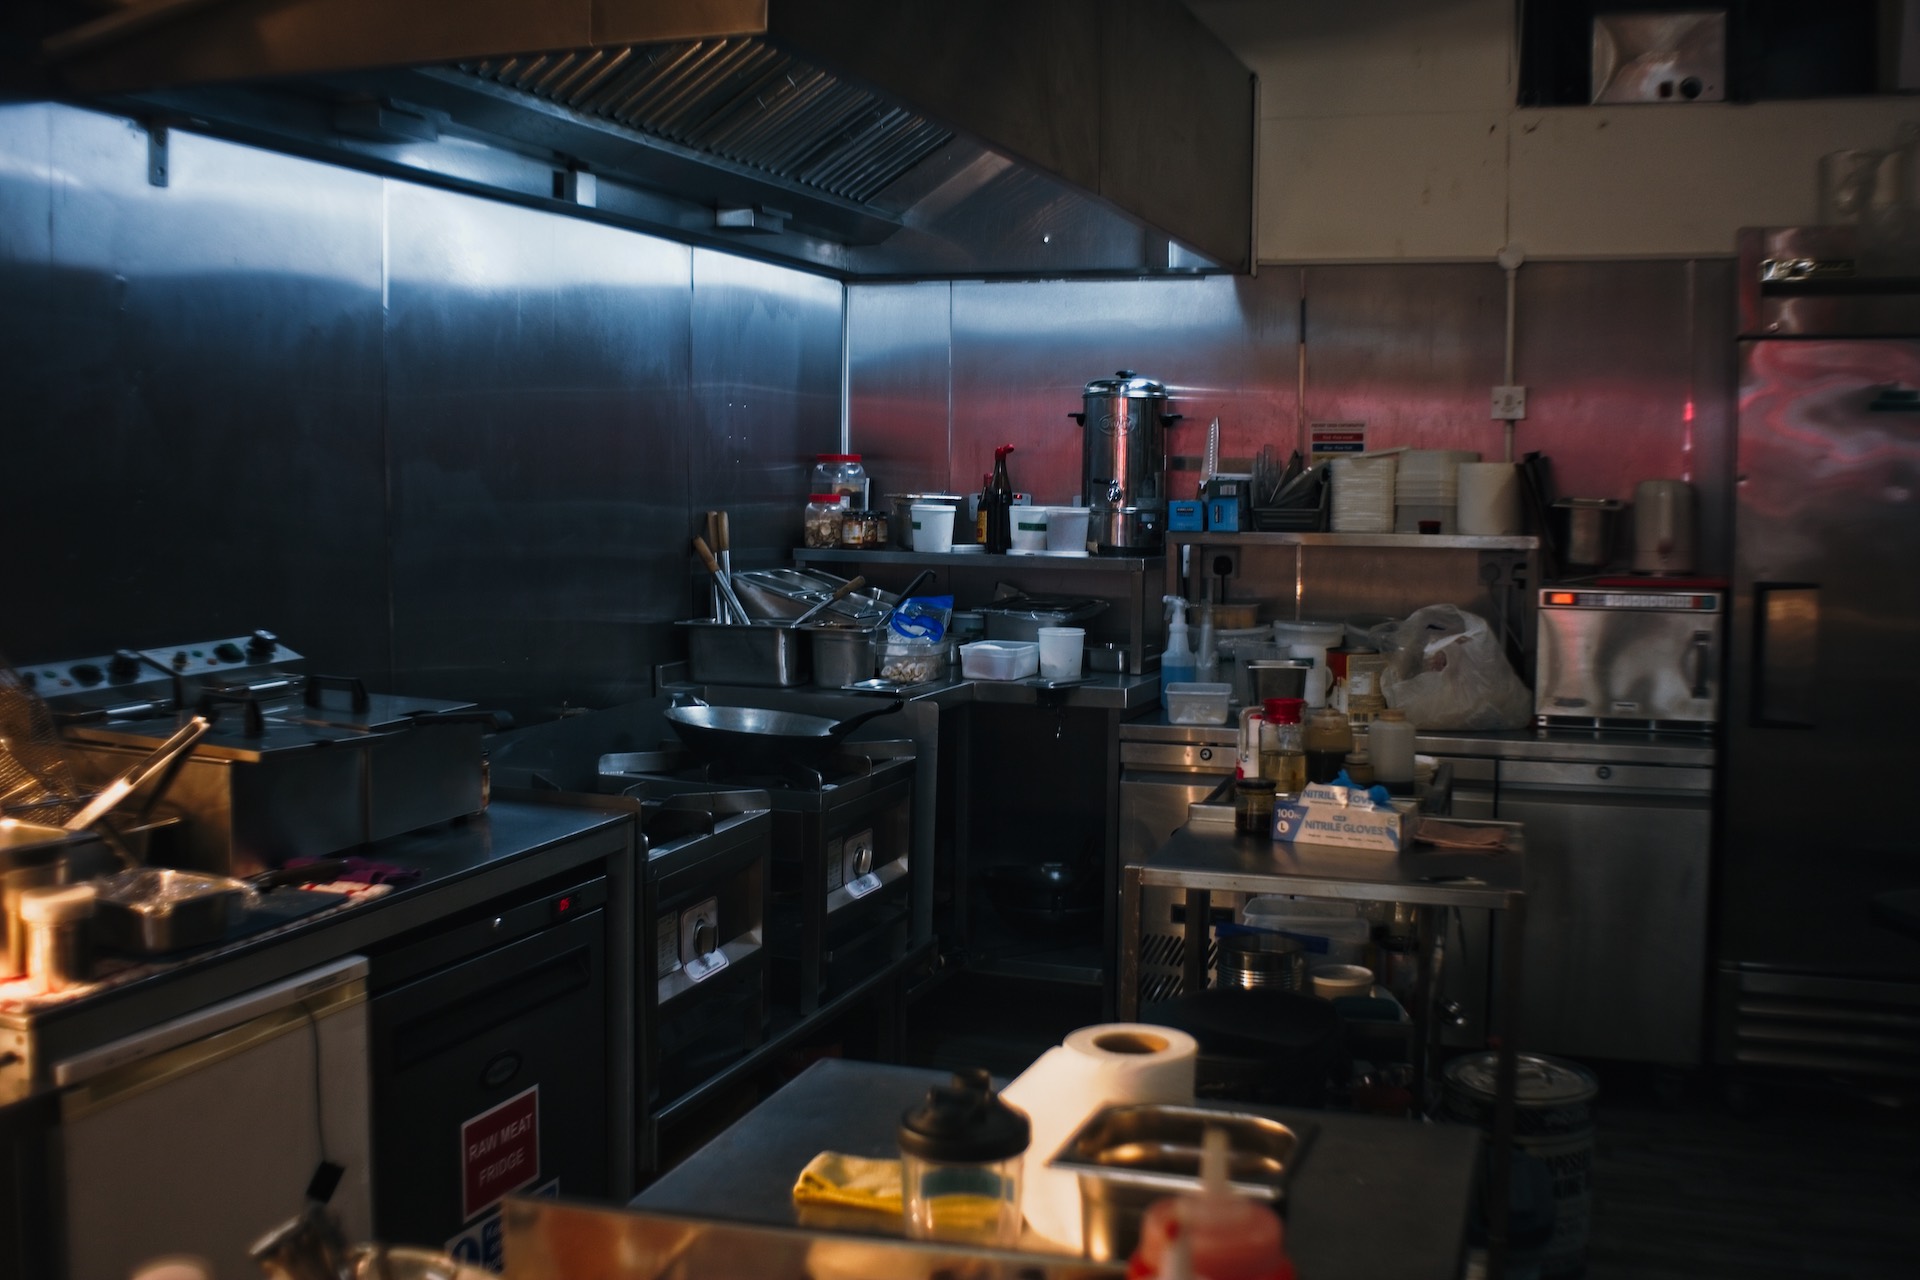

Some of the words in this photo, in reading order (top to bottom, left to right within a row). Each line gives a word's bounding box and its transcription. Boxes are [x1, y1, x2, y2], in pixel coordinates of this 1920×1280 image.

[1303, 790, 1337, 800] NITRILE
[1305, 820, 1341, 832] NITRILE
[1343, 823, 1383, 835] GLOVES
[469, 1132, 499, 1163] RAW
[500, 1113, 533, 1144] MEAT
[479, 1146, 525, 1188] FRIDGE
